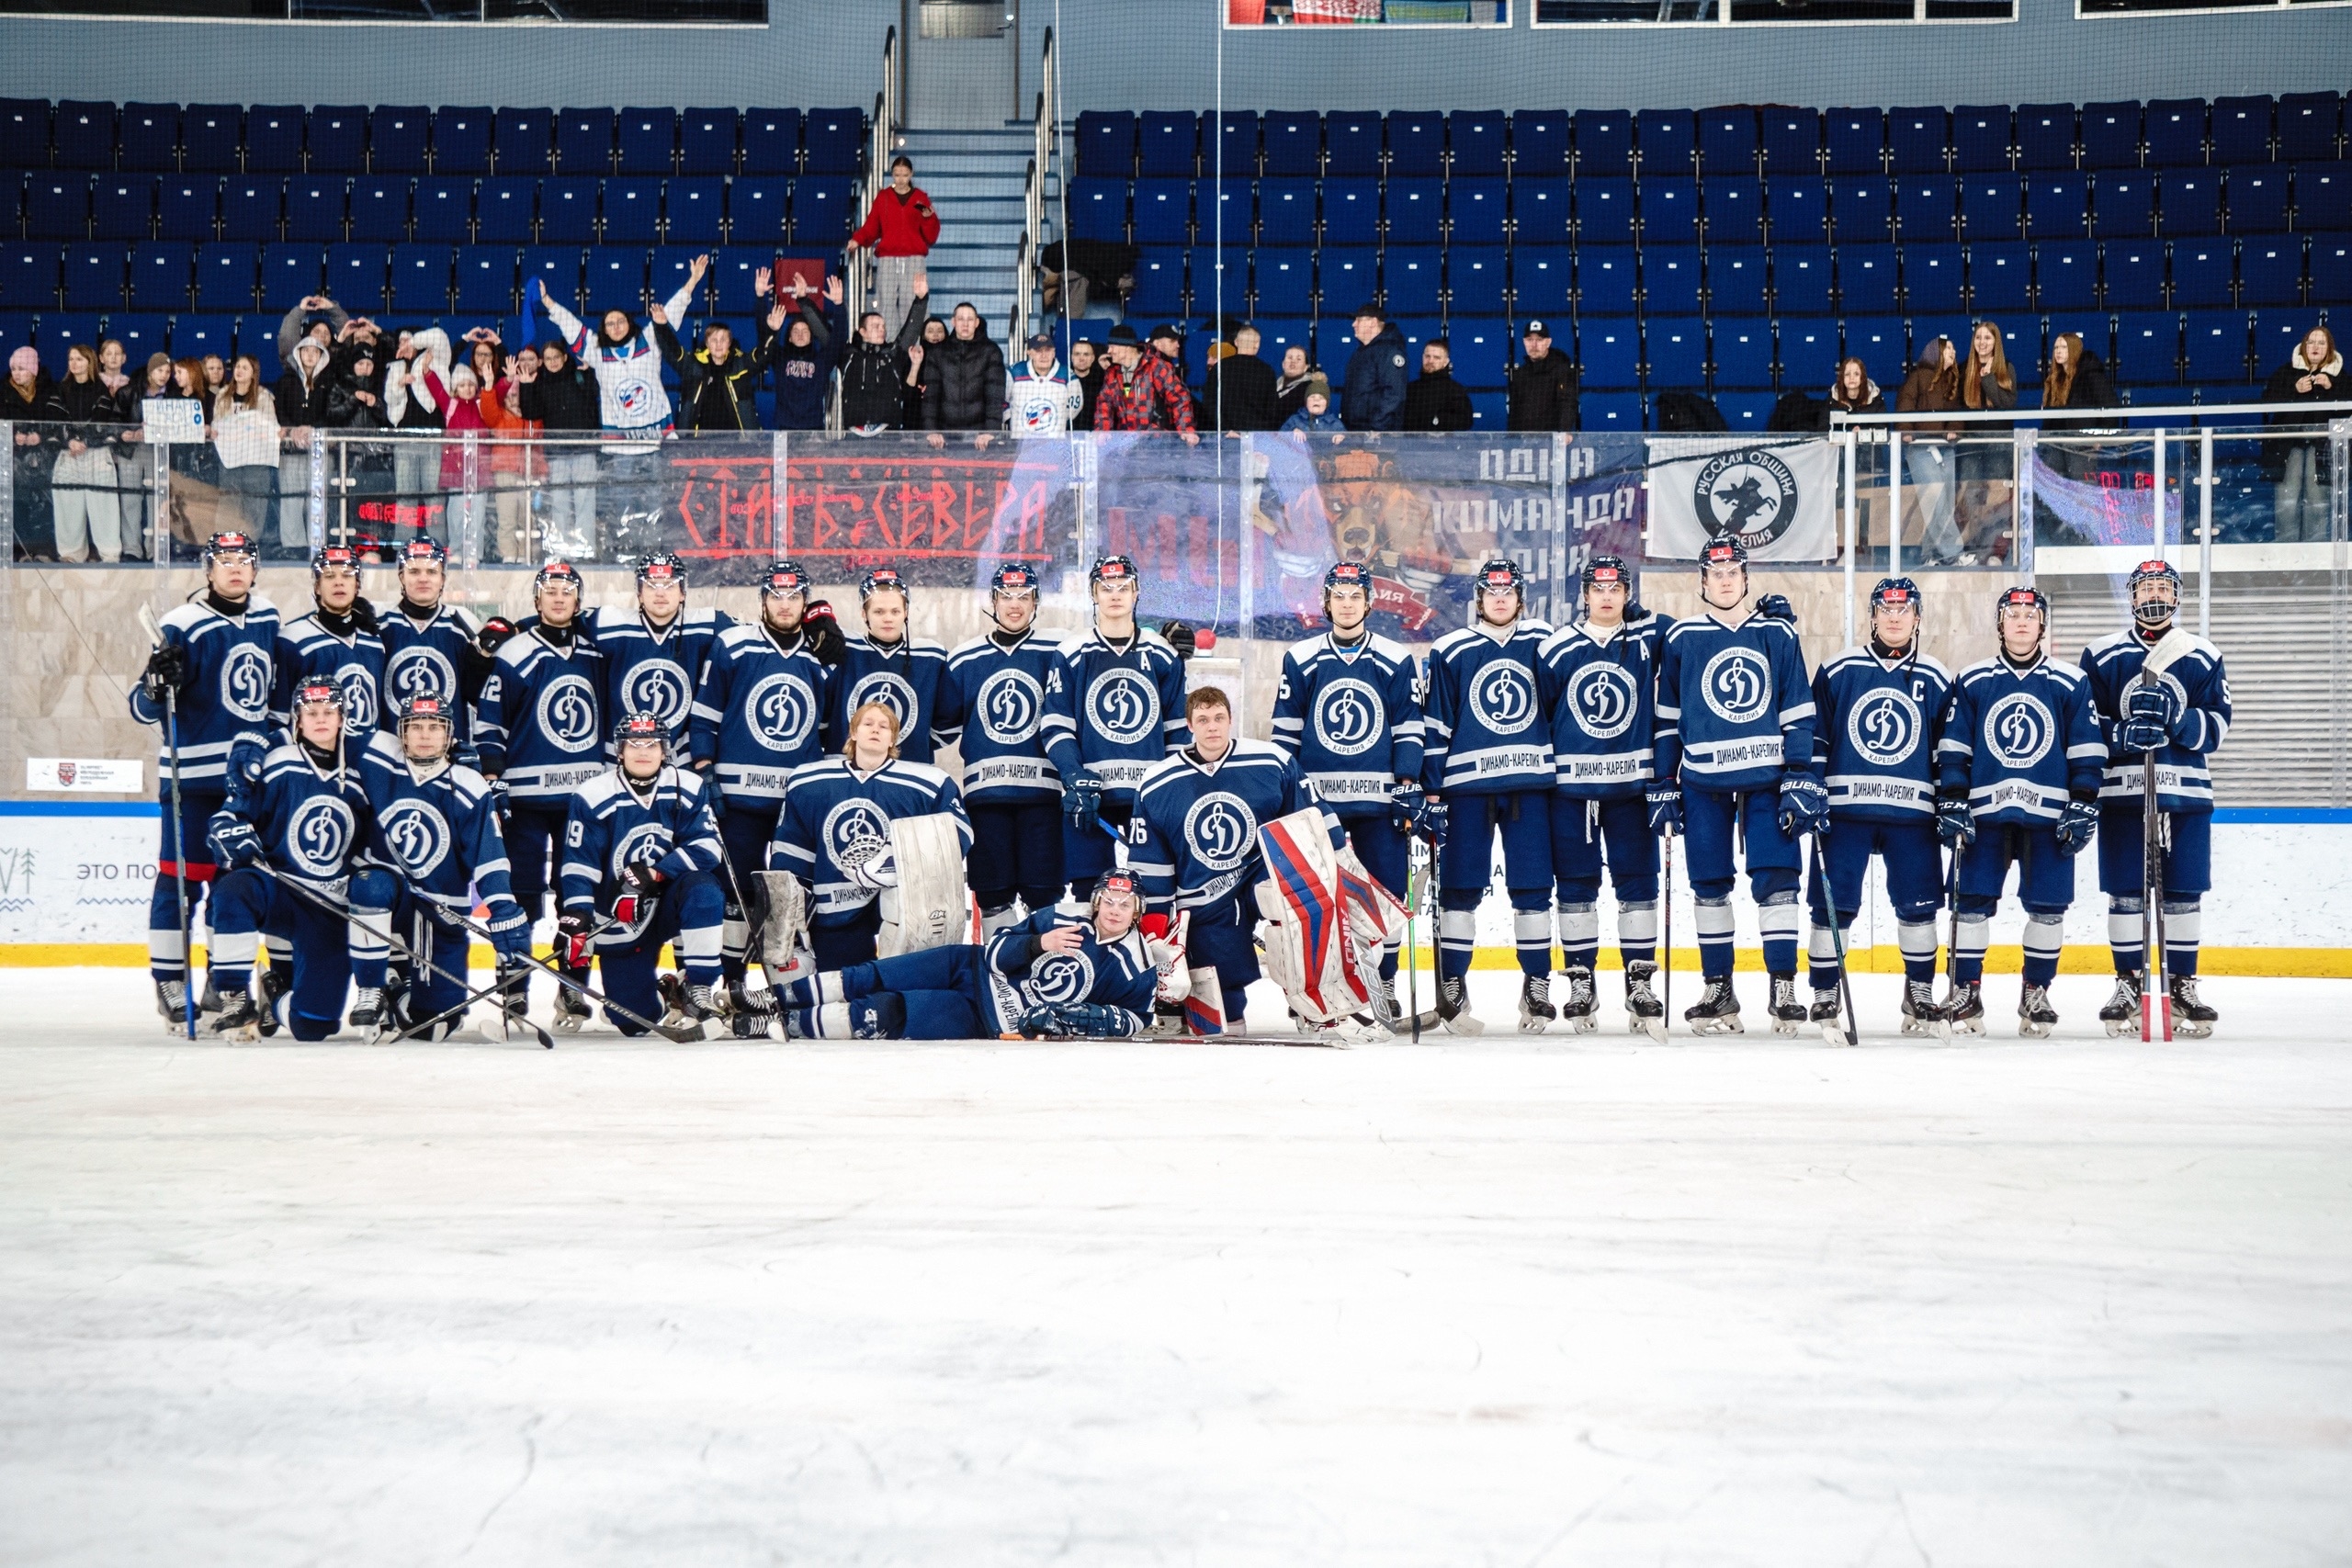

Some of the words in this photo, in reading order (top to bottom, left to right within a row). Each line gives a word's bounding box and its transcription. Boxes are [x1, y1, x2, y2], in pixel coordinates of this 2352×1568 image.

[1697, 451, 1744, 496] РУССКАЯ
[1749, 451, 1794, 496] ОБЩИНА
[1728, 710, 1760, 722] КАРЕЛИЯ
[1495, 722, 1524, 733] КАРЕЛИЯ
[1588, 727, 1621, 737] КАРЕЛИЯ
[766, 739, 797, 750] КАРЕЛИЯ
[1110, 732, 1141, 743] КАРЕЛИЯ
[1333, 743, 1365, 754] КАРЕЛИЯ
[1716, 742, 1780, 767] ДИНАМО-КАРЕЛИЯ
[1480, 753, 1540, 774] ДИНАМО-КАРЕЛИЯ
[1868, 754, 1900, 764] КАРЕЛИЯ
[981, 763, 1038, 783] ДИНАМО-КАРЕЛИЯ
[1575, 759, 1637, 778] ДИНАМО-КАРЕЛИЯ
[745, 773, 789, 789] ДИНАМО-КА
[1319, 779, 1381, 795] ДИНАМО-КАРЕЛИЯ
[1852, 782, 1916, 802] ДИНАМО-КАРЕЛИЯ
[1211, 856, 1240, 869] КАРЕЛИ
[77, 864, 119, 880] ЭТО
